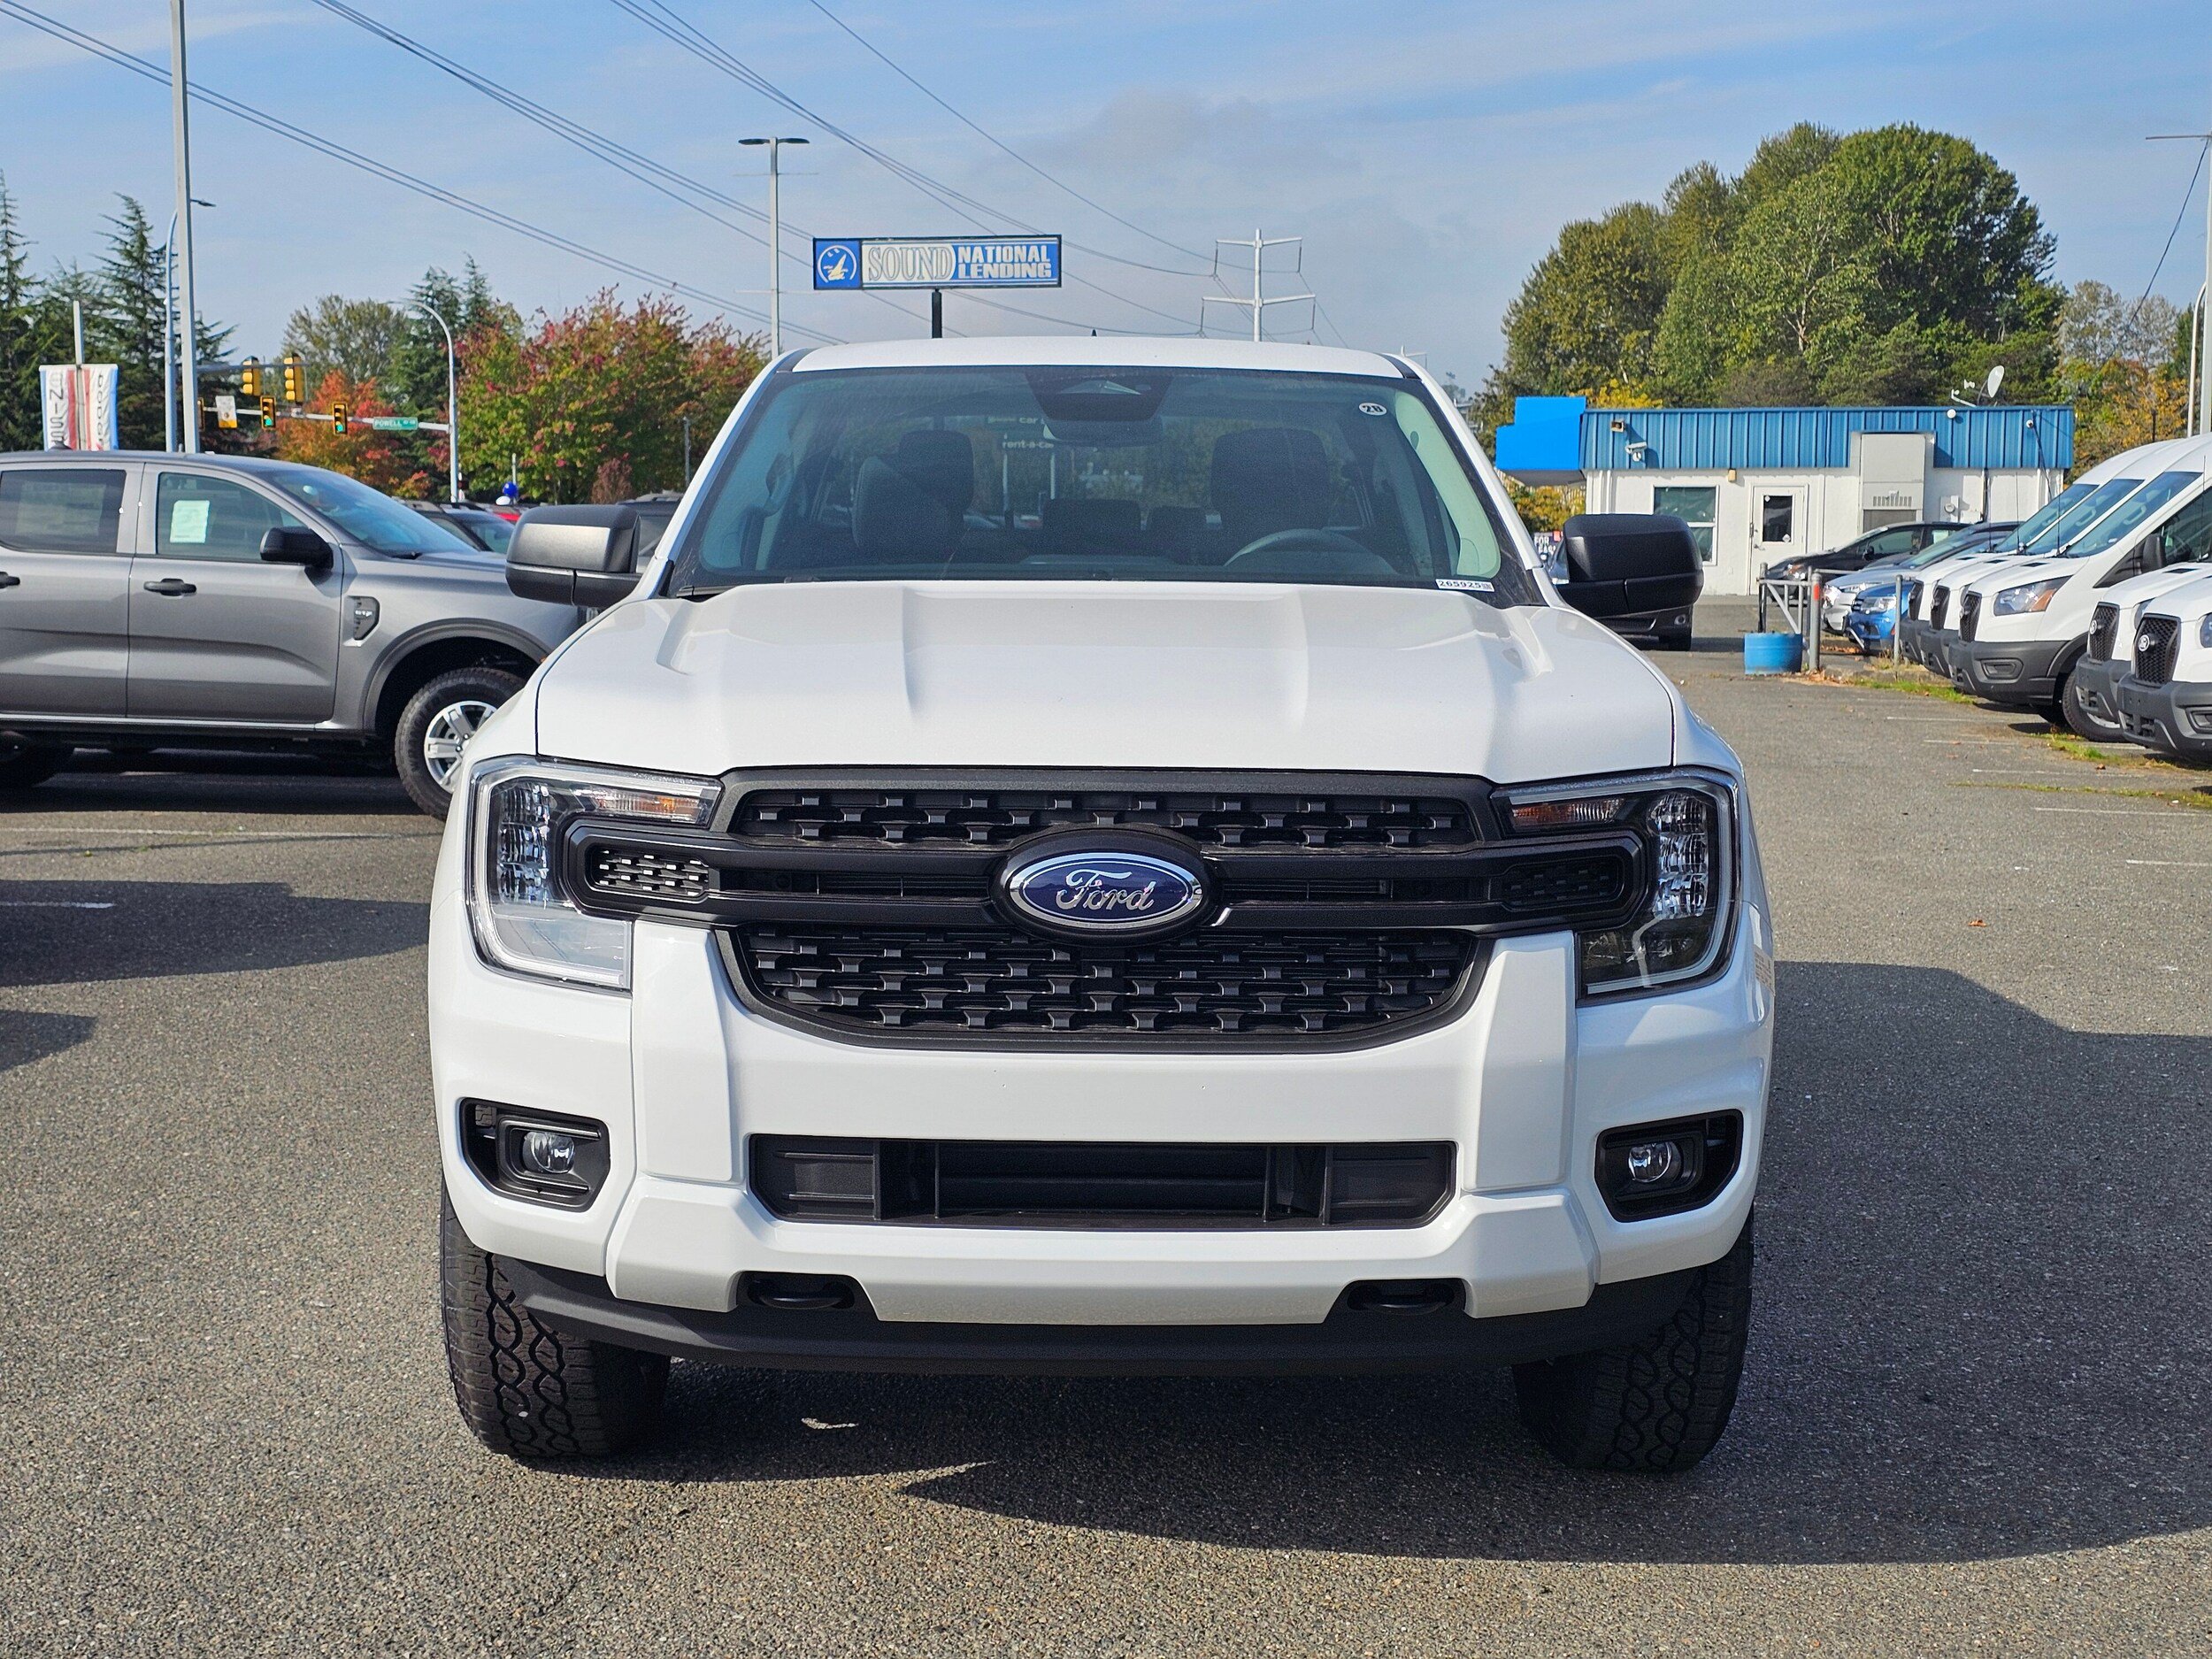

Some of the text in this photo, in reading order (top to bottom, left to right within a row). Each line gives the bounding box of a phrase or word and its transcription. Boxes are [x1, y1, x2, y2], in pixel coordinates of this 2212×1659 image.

[868, 246, 954, 281] SOUND
[957, 245, 1051, 264] NATIONAL
[957, 263, 1052, 279] LENDING
[1056, 869, 1156, 910] Ford
